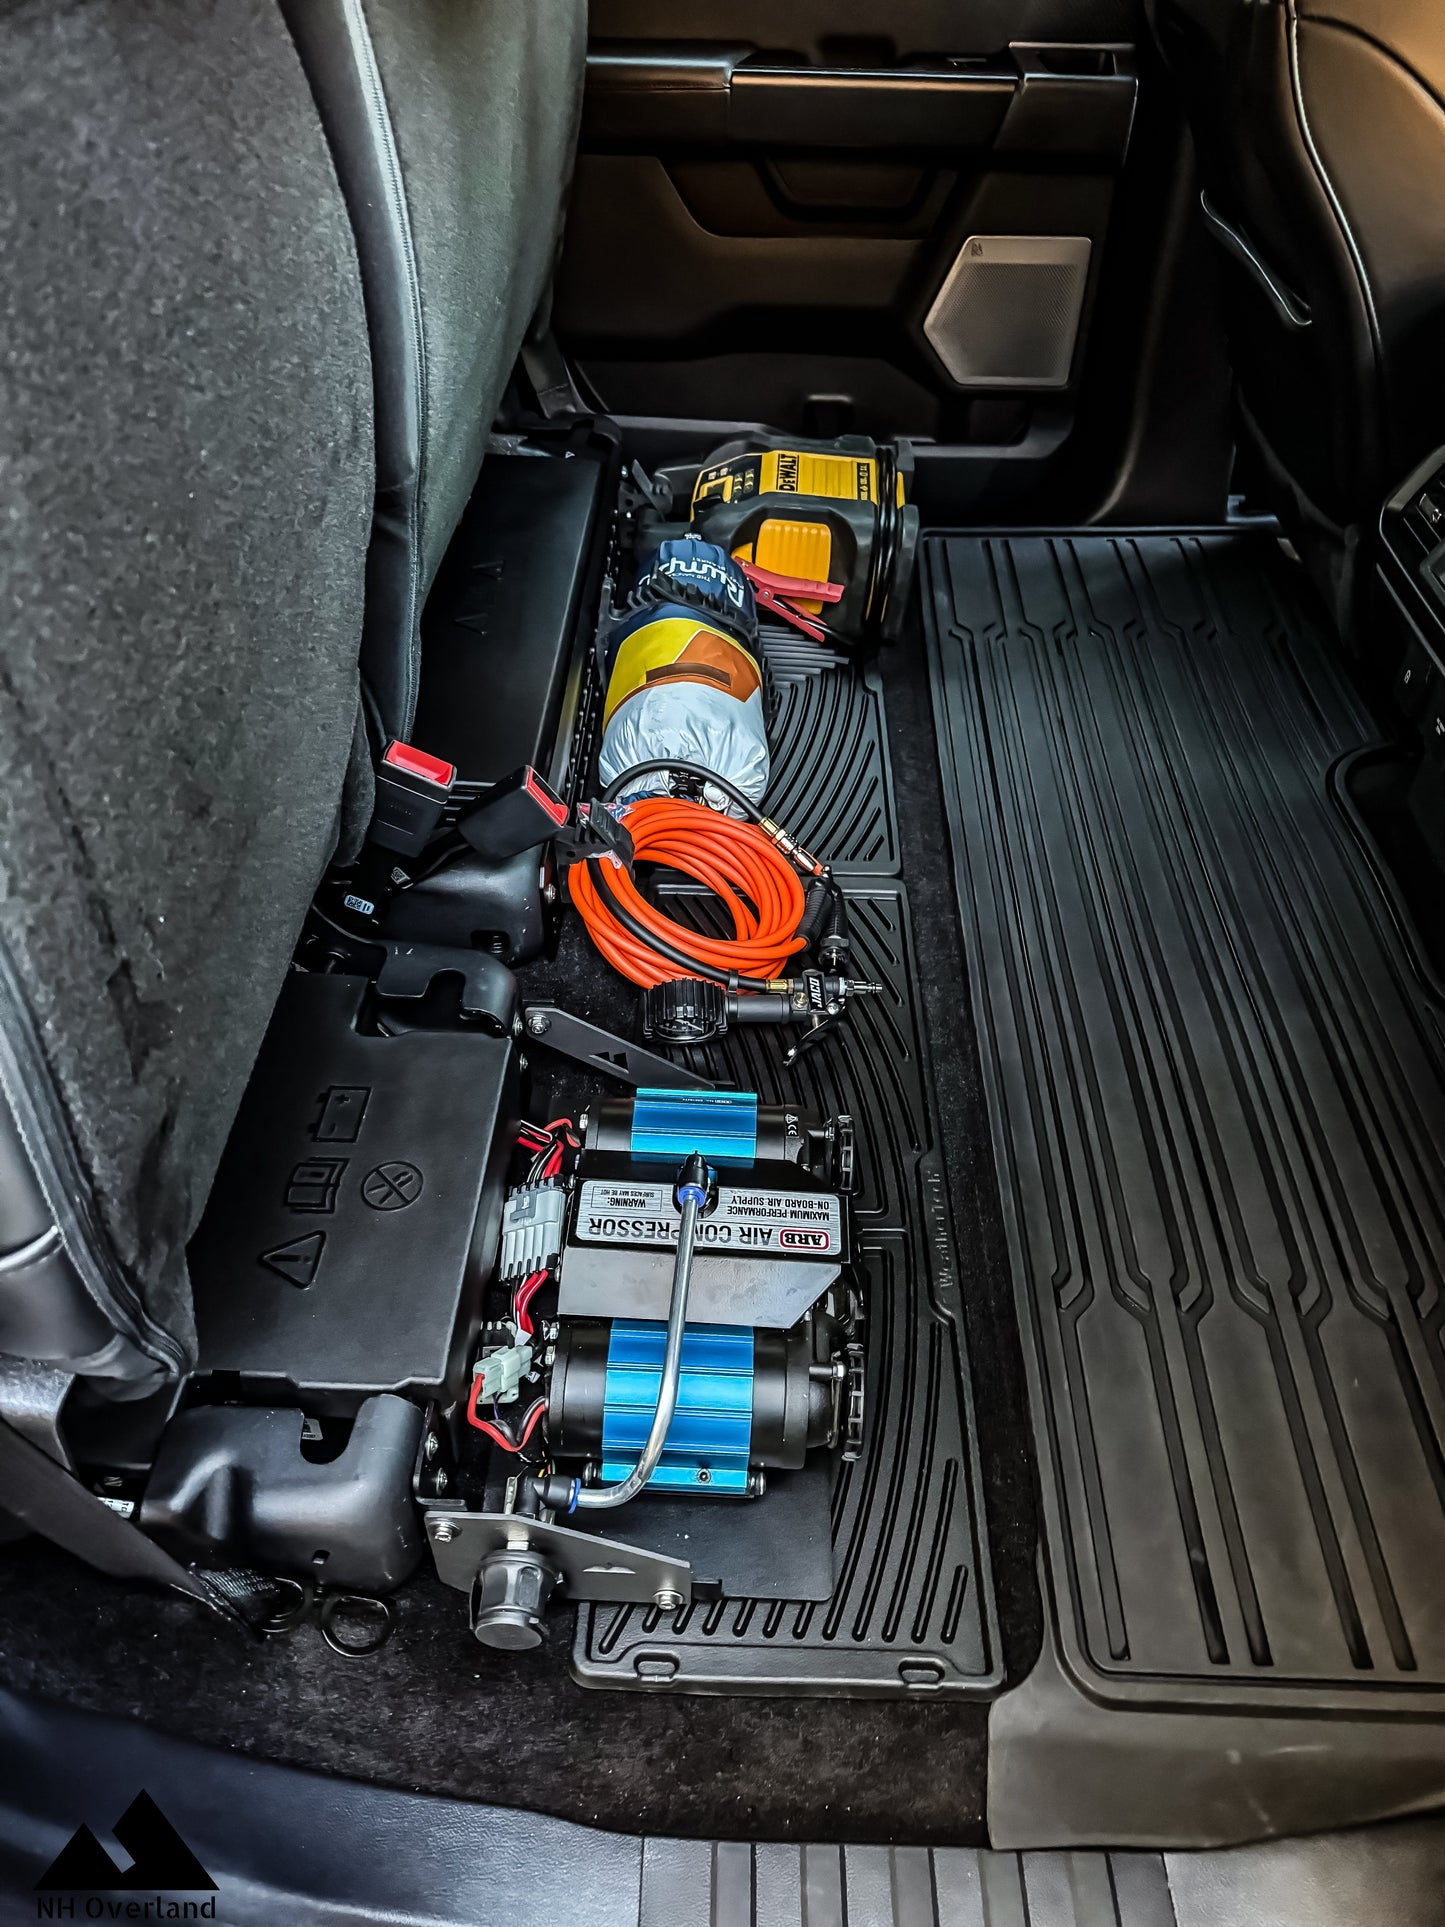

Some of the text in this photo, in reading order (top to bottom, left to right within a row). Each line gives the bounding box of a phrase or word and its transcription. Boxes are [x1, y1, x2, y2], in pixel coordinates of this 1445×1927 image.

[808, 977, 822, 1008] JACO
[630, 1190, 655, 1198] SURFACES
[607, 1196, 646, 1208] WARNING:
[731, 1195, 830, 1210] ON-BOARD AIR SUPPLY
[727, 1205, 830, 1221] MAXIMUM PERFORMANCE
[740, 1226, 773, 1246] AIR
[784, 1232, 823, 1246] ARB
